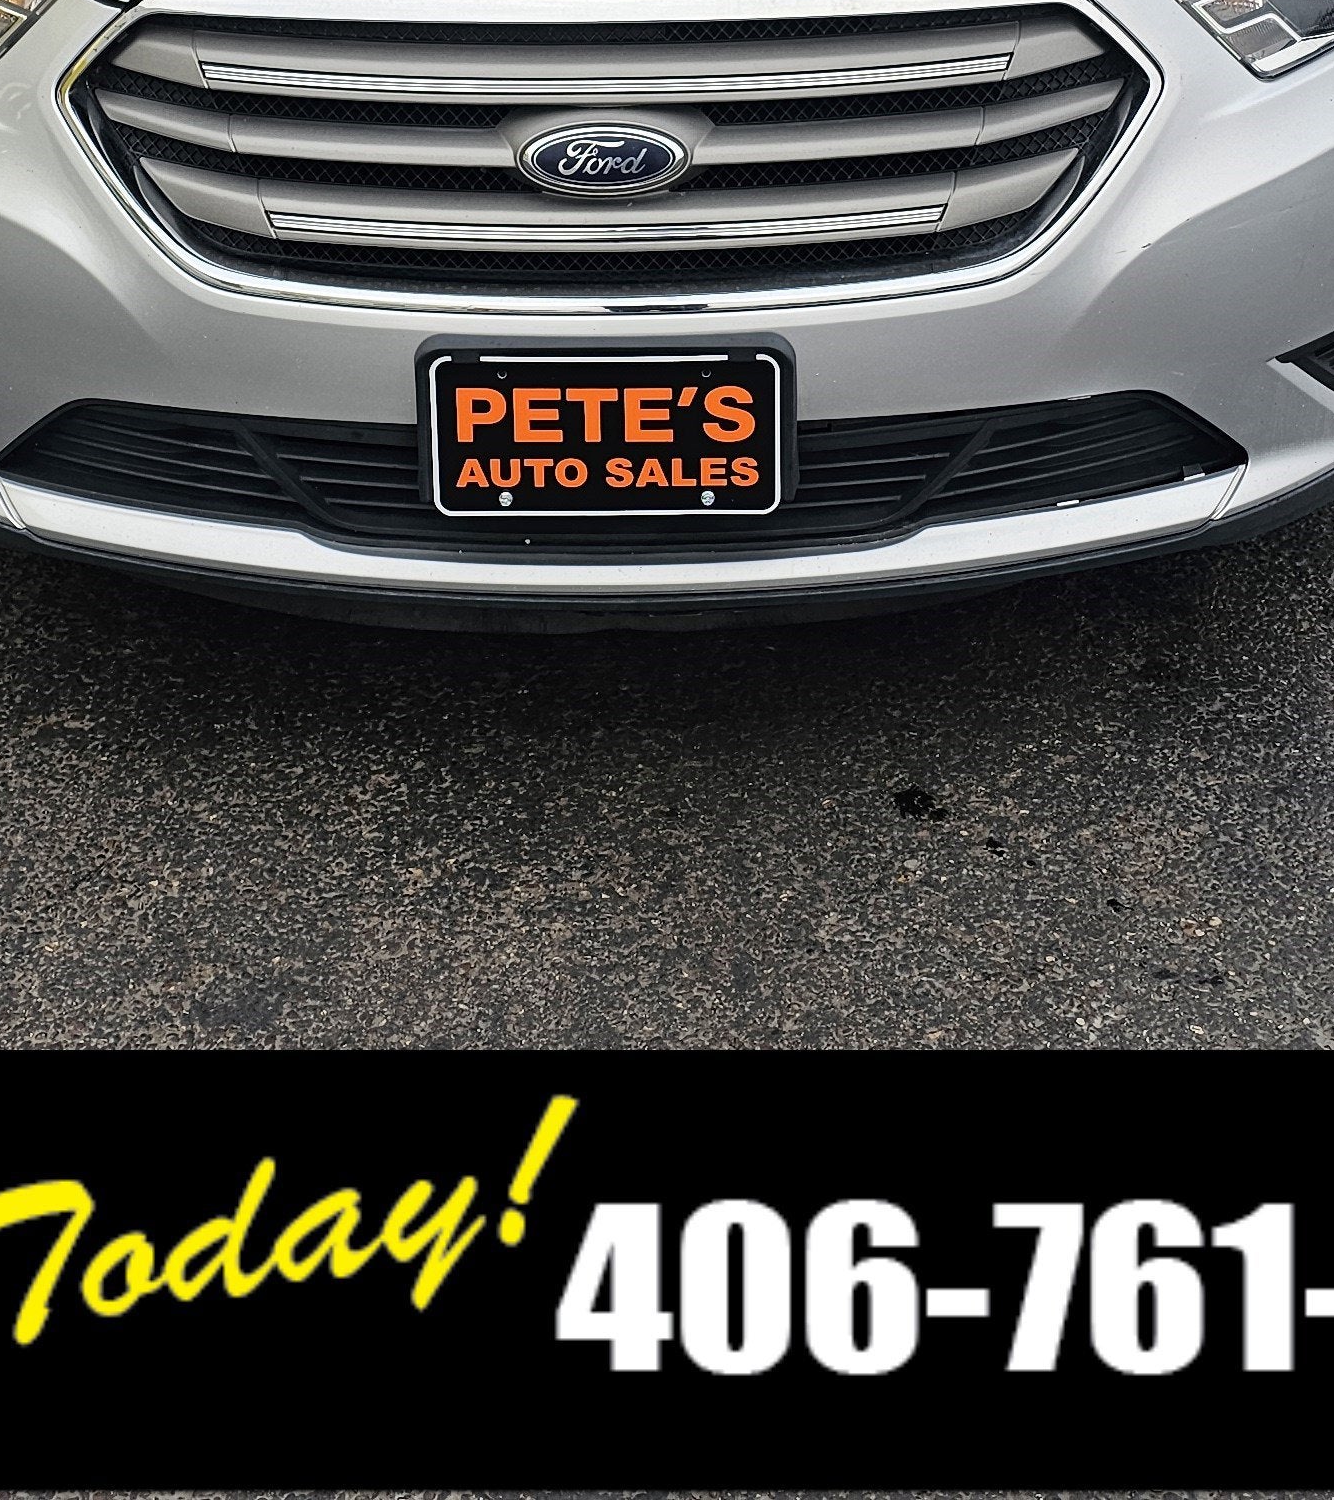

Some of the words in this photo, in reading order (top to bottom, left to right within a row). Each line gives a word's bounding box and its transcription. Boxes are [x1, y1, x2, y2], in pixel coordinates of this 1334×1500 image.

[557, 139, 647, 176] Ford
[455, 385, 756, 443] PETE'S
[455, 457, 588, 488] AUTO
[605, 457, 759, 488] SALES
